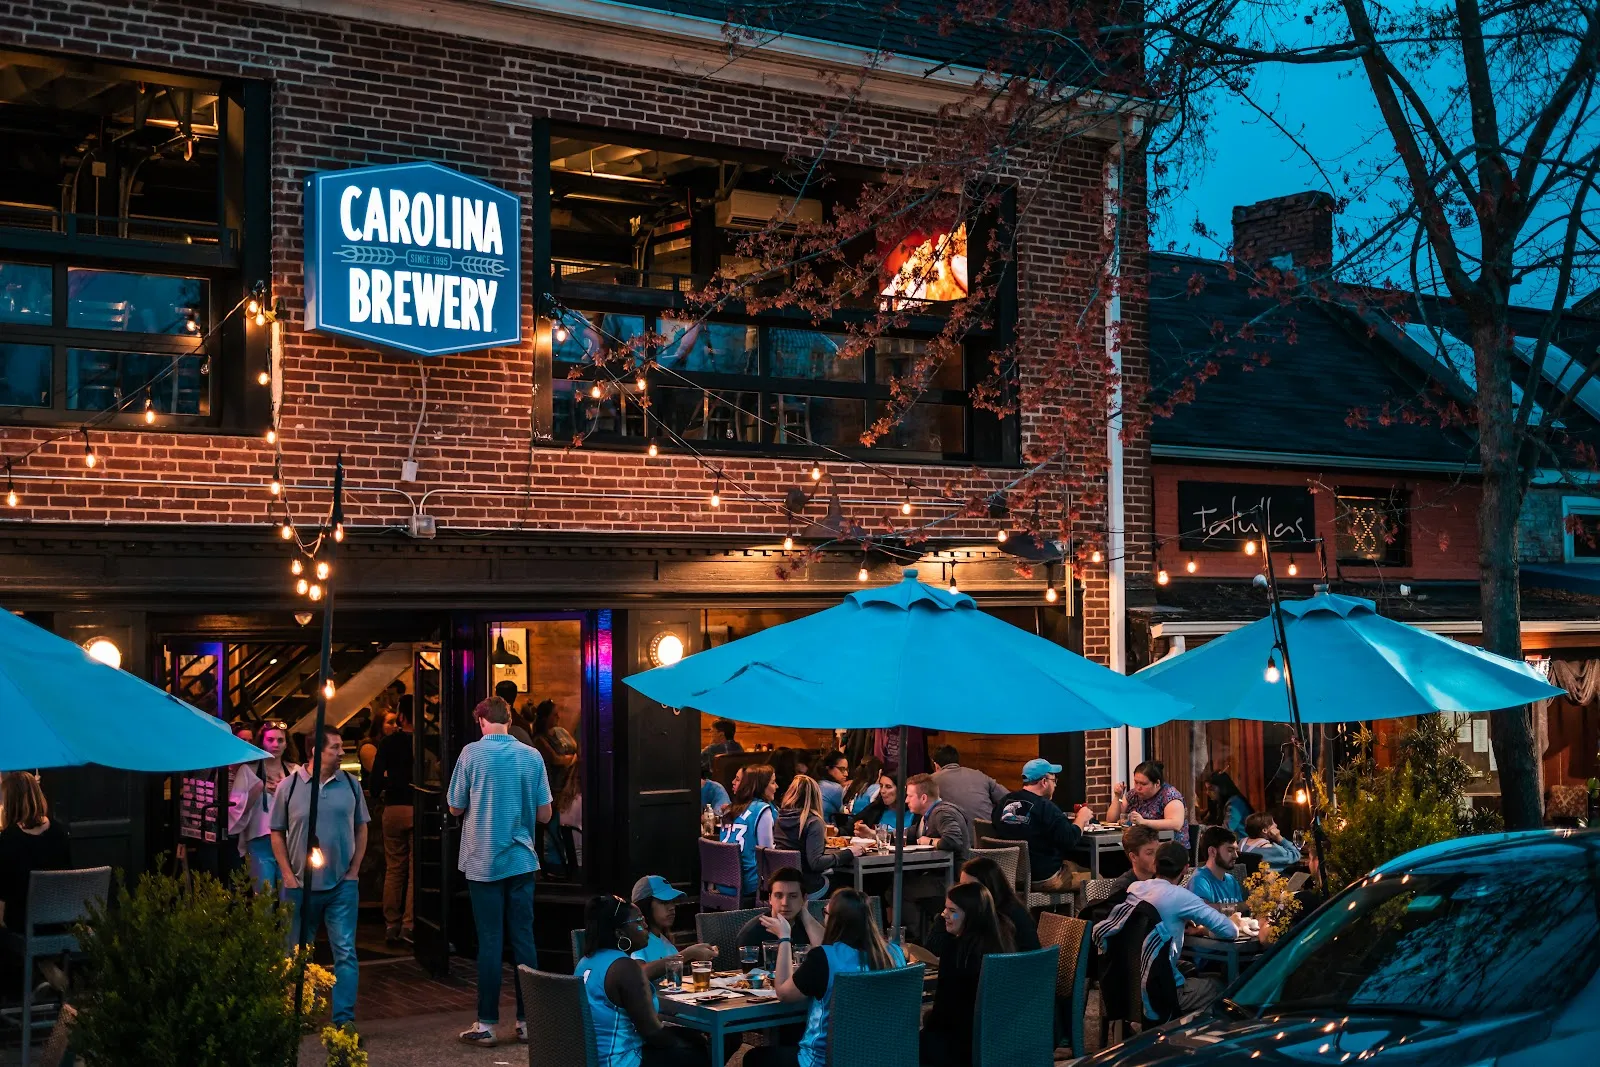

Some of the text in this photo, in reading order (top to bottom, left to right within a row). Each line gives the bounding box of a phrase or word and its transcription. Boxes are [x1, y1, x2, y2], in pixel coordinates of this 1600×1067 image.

[340, 185, 503, 255] CAROLINA
[433, 255, 449, 266] 1995
[349, 267, 498, 332] BREWERY
